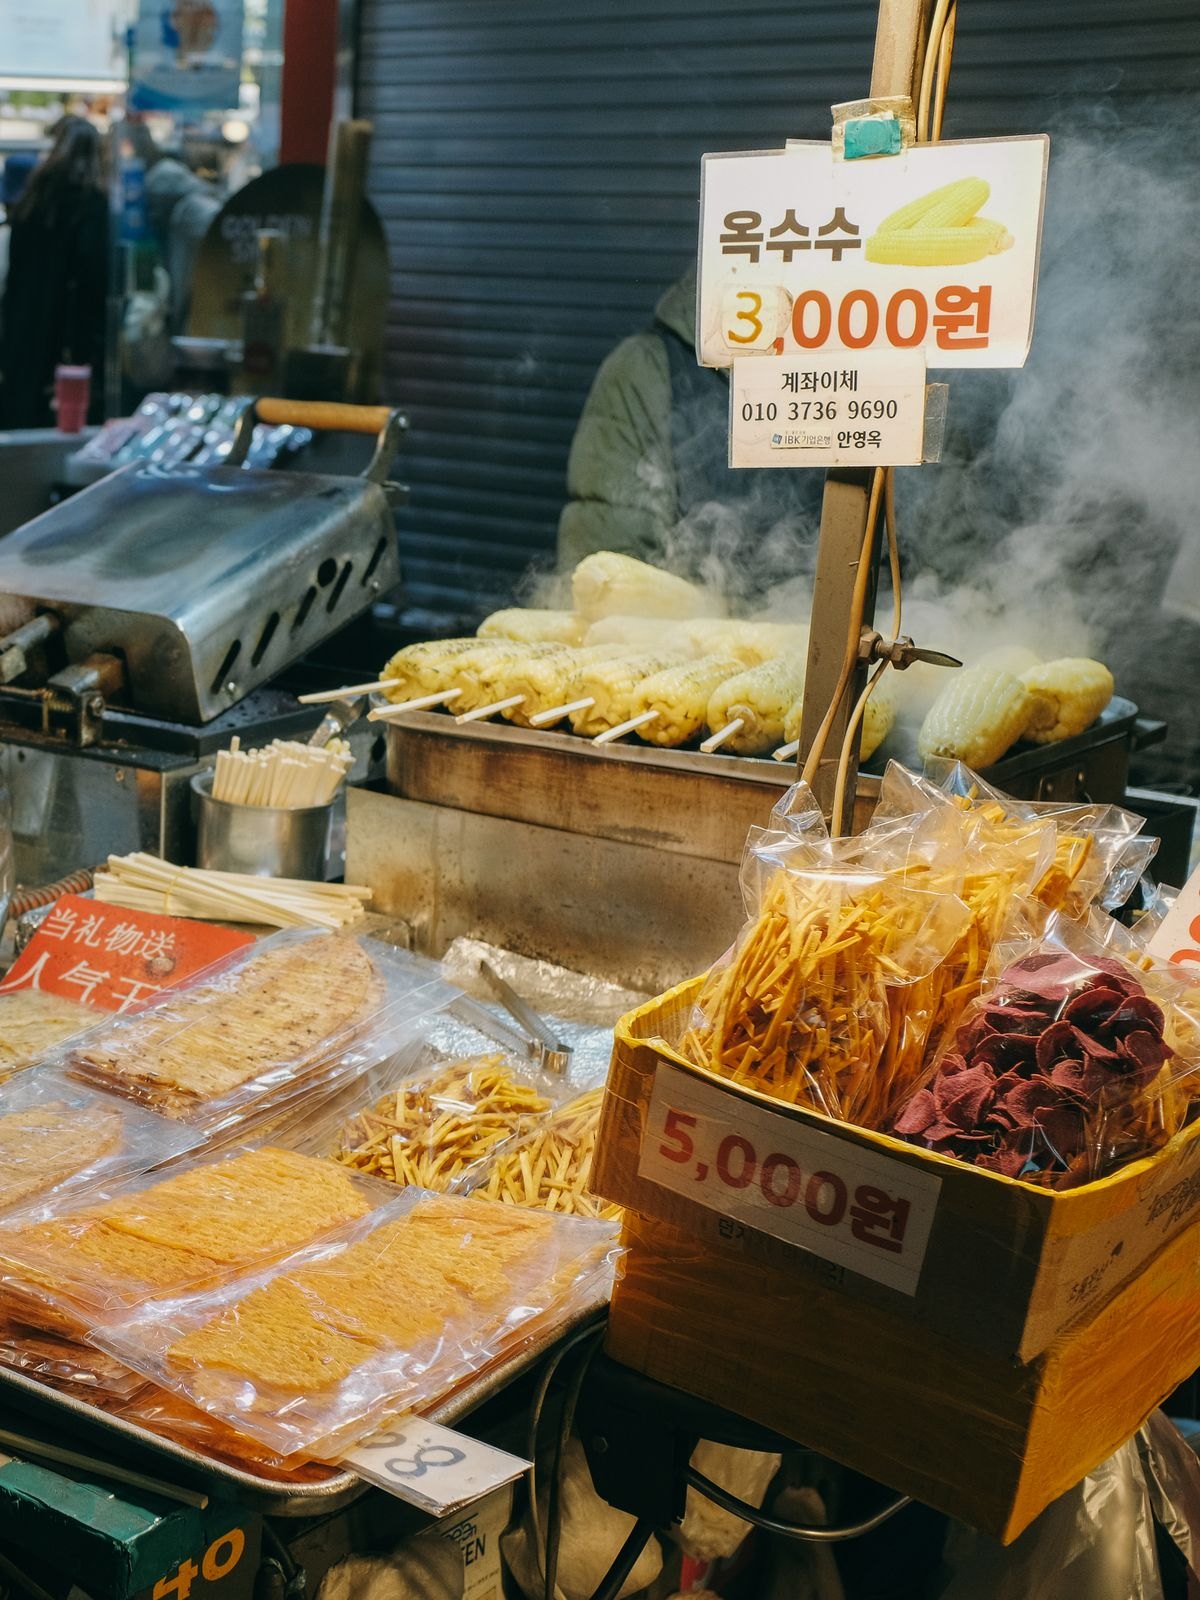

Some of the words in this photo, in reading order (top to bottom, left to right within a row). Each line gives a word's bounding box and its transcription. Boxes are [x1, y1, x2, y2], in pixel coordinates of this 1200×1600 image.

[719, 207, 862, 263] 옥수수
[728, 285, 992, 355] 3,000원
[781, 370, 858, 393] 계좌이체
[742, 402, 777, 421] 010
[788, 401, 837, 420] 3736
[848, 400, 898, 419] 9690
[837, 430, 882, 449] 안영옥
[40, 908, 175, 961] 当礼物送
[659, 1108, 912, 1254] 5,000원
